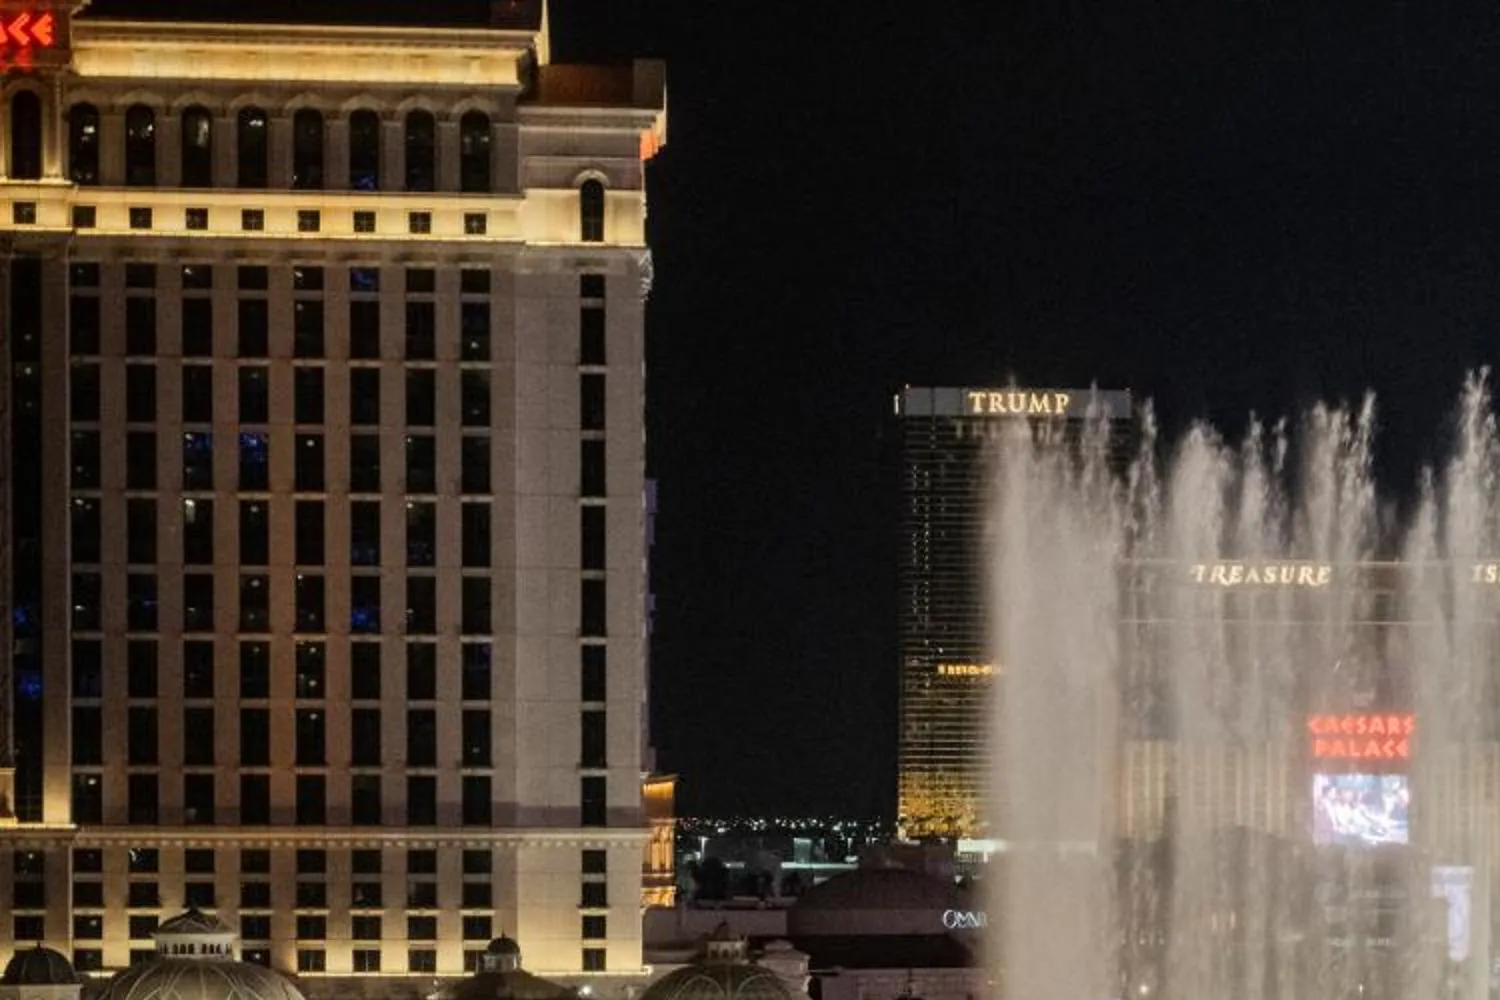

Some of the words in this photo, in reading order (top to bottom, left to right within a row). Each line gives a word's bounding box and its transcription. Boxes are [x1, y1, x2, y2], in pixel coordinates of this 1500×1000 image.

[968, 391, 1070, 414] TRUMP
[1191, 563, 1332, 587] TREASURE
[1308, 714, 1416, 735] CAESARS
[1313, 738, 1409, 758] PALACE
